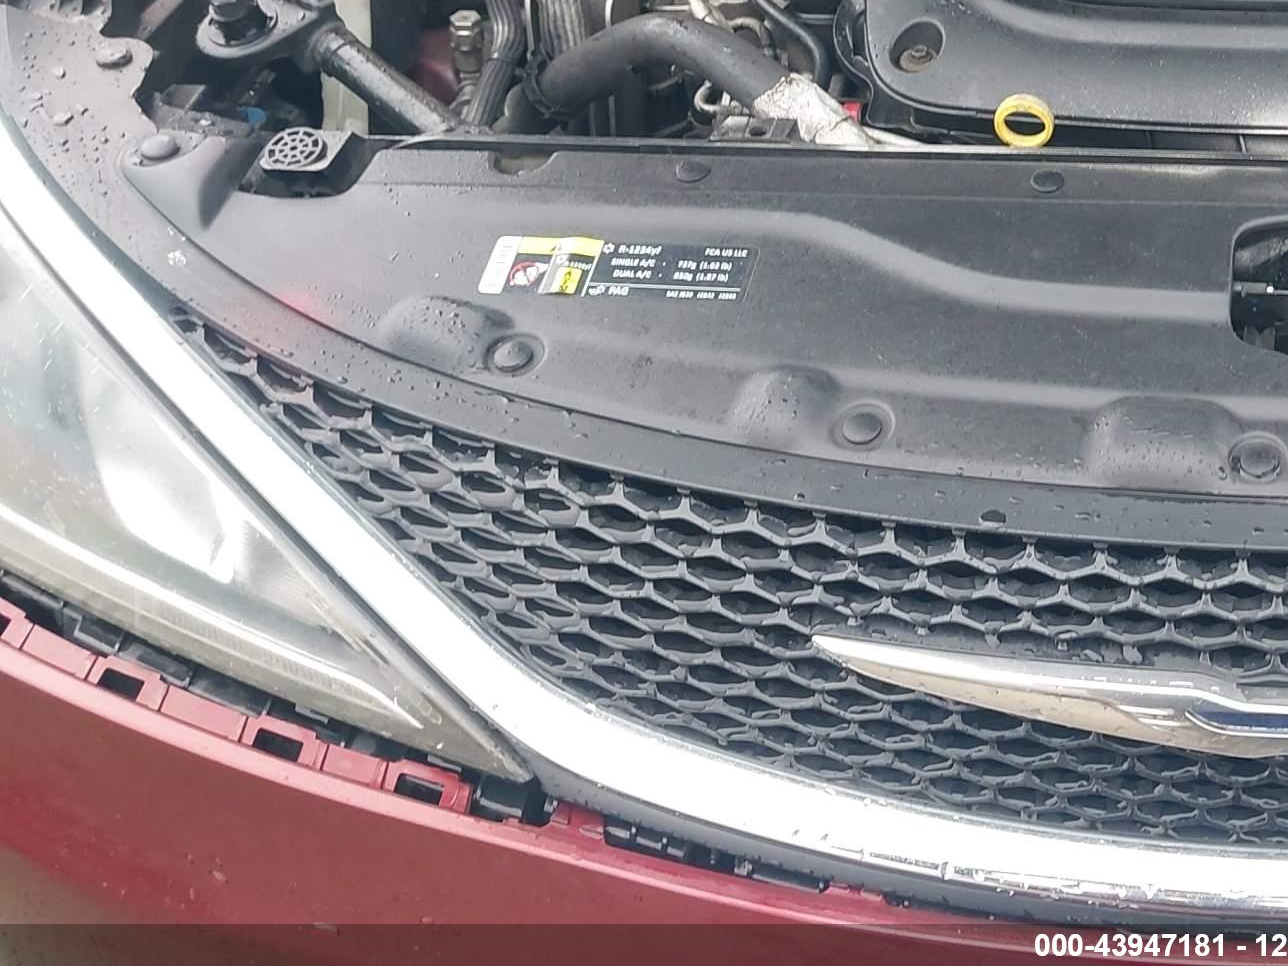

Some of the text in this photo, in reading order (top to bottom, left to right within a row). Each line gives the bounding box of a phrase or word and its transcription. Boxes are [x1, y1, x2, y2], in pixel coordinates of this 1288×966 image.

[705, 247, 720, 256] FCA
[721, 248, 733, 257] US
[611, 257, 639, 266] SINGLE
[640, 258, 656, 267] A/C
[612, 269, 635, 278] DUAL
[636, 270, 652, 279] A/C
[608, 286, 629, 296] PAG
